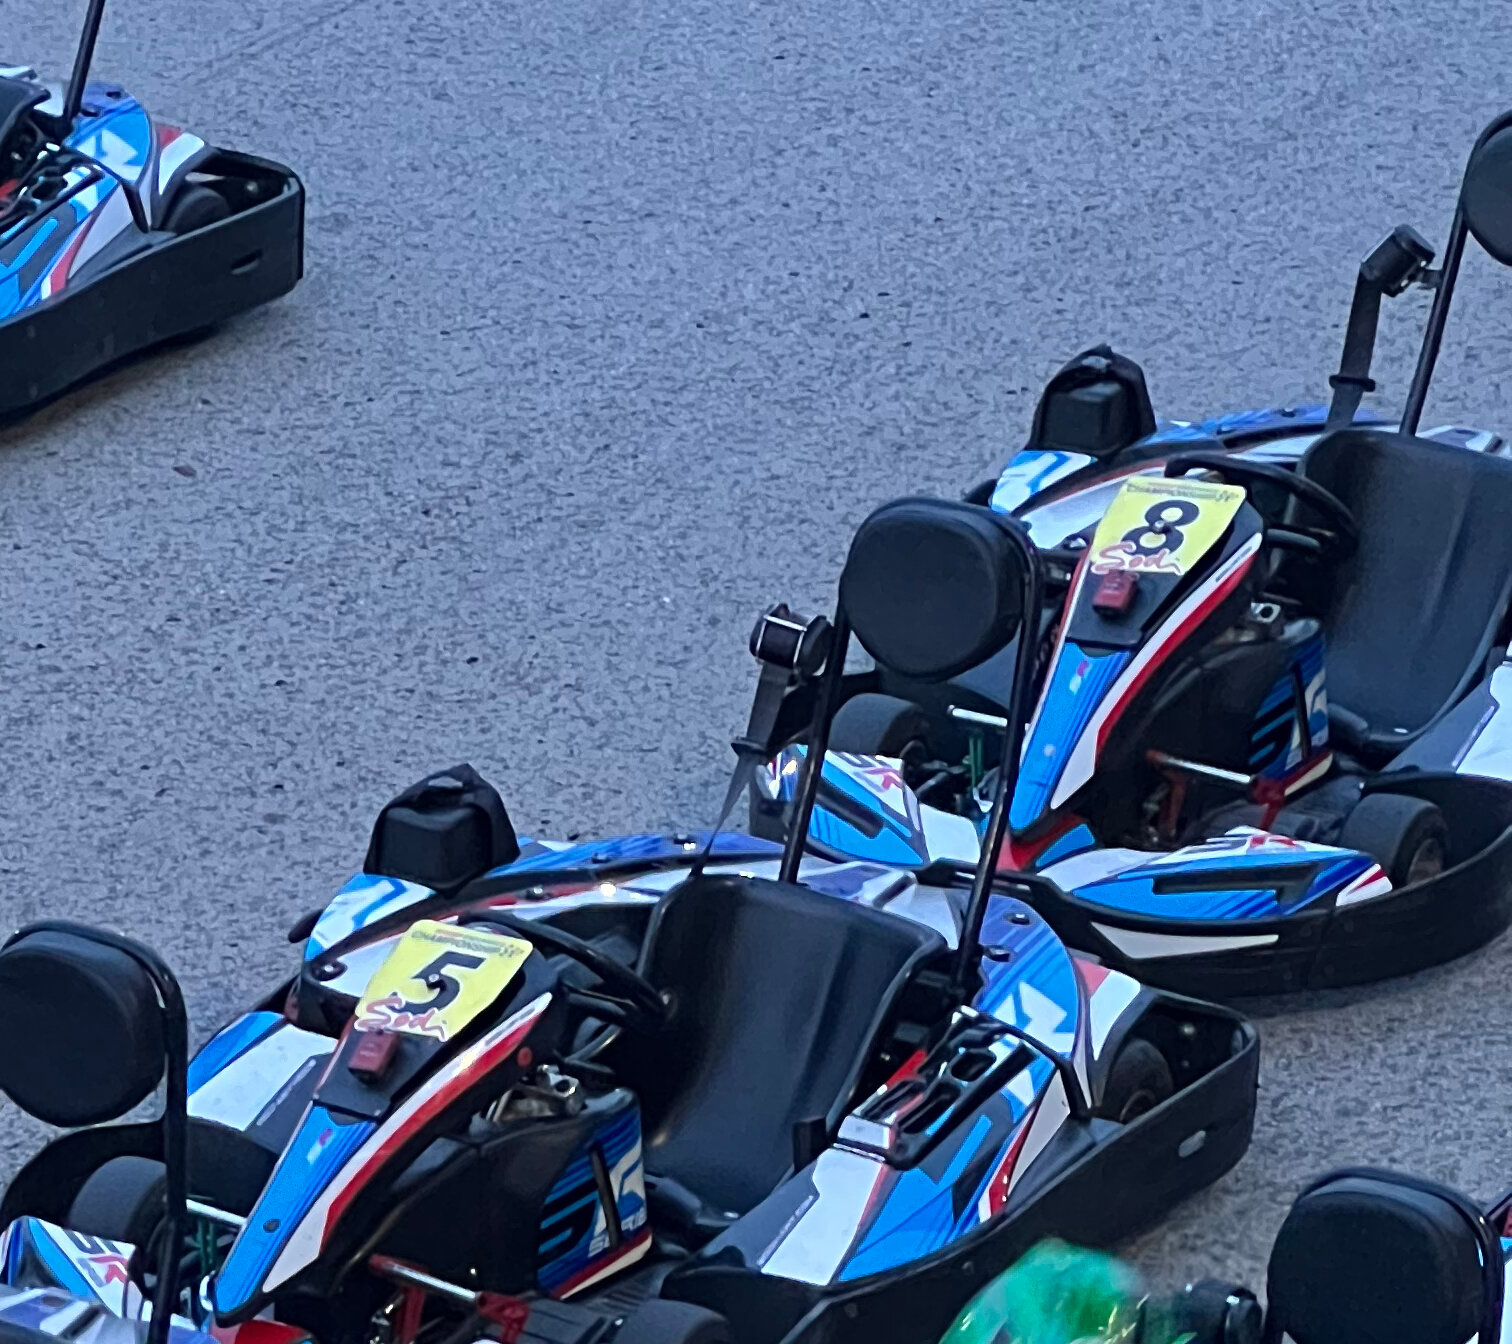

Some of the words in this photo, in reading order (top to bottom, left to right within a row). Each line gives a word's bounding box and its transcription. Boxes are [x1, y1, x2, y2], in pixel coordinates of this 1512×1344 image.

[1121, 500, 1199, 556] 8
[389, 951, 487, 1016] 5
[355, 995, 449, 1042] Sodi
